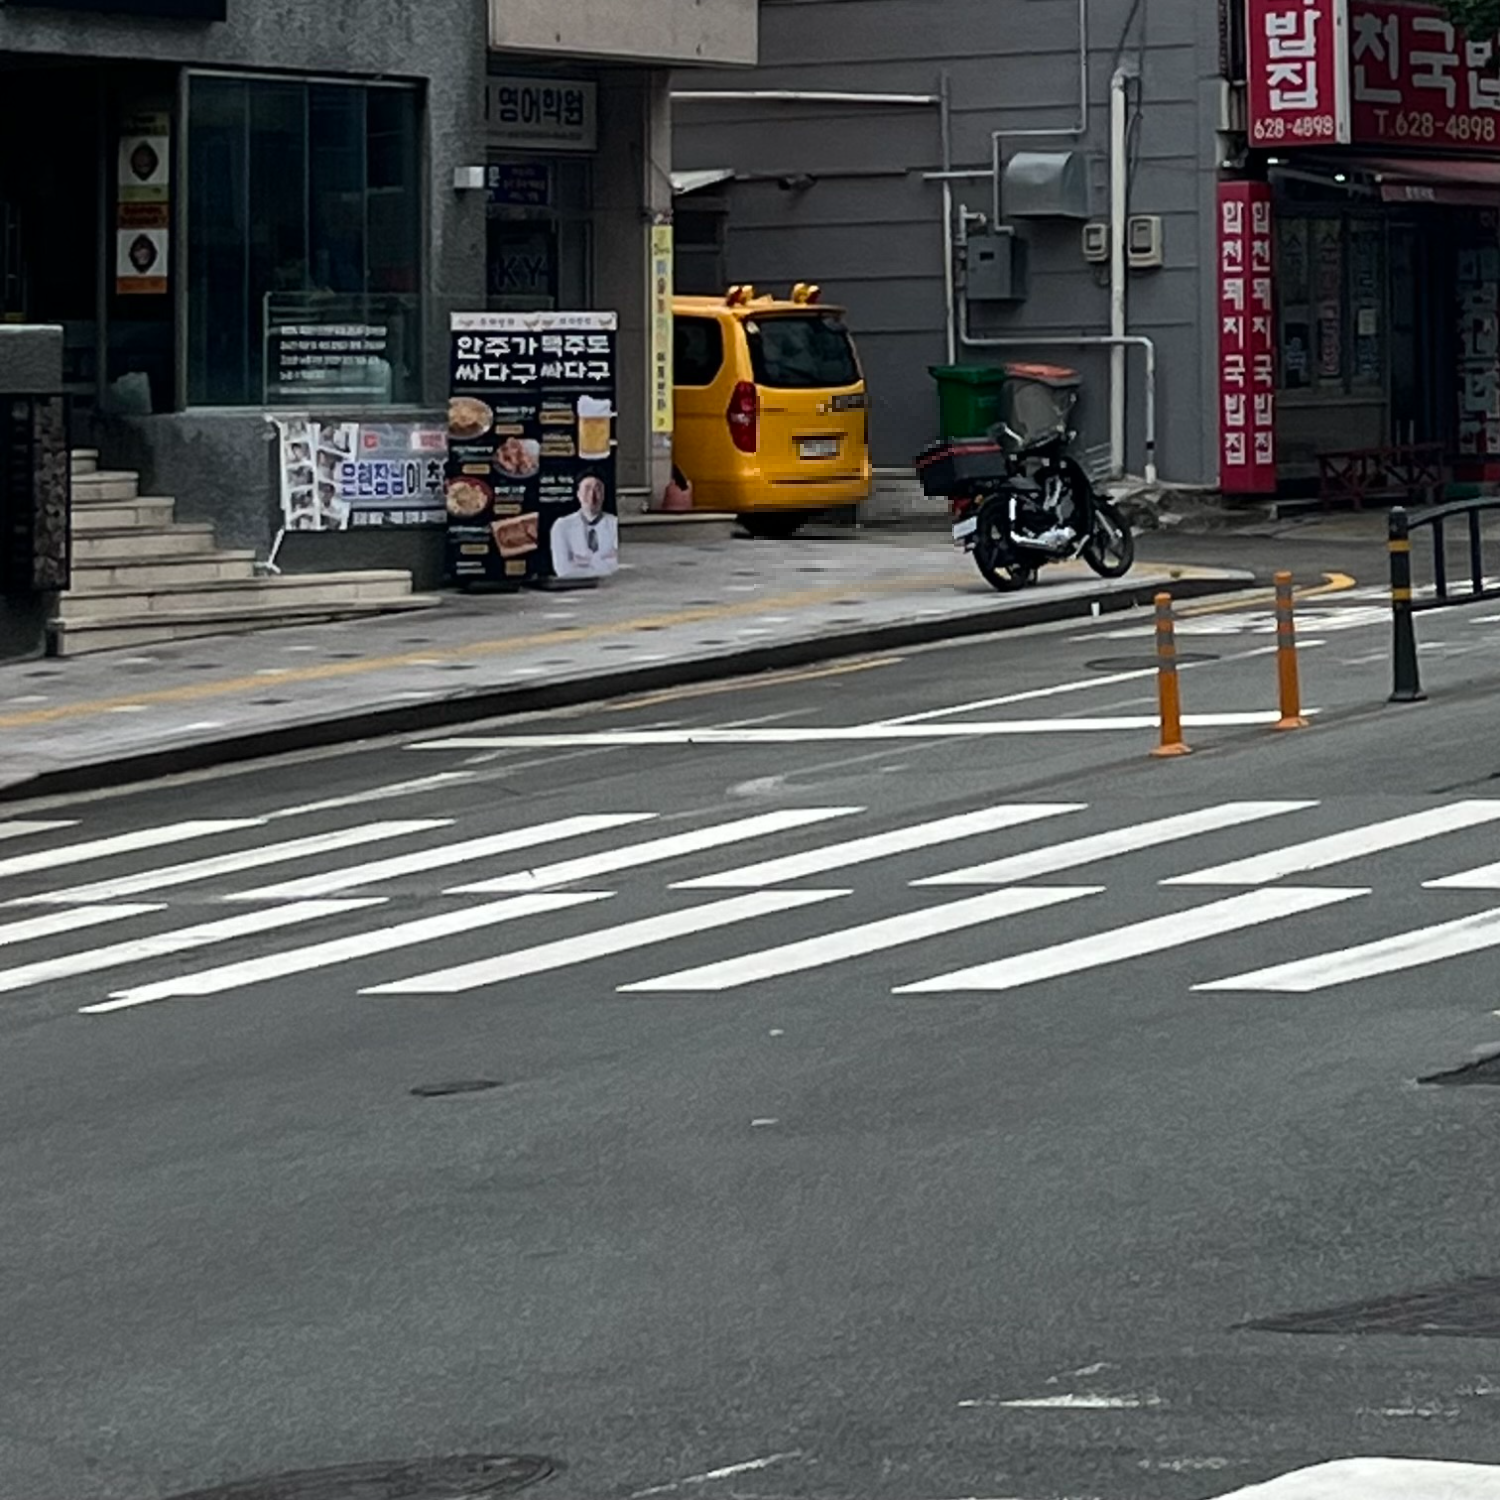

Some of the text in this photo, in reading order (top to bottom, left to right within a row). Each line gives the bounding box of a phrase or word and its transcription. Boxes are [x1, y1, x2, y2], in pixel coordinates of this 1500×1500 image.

[499, 87, 585, 127] 영어학원
[1254, 115, 1335, 140] 628-4898
[1374, 109, 1496, 142] T.628-4898
[457, 335, 538, 360] 안주가
[541, 335, 611, 358] 맥주도
[455, 362, 538, 384] 싸다구
[540, 360, 611, 381] 싸다구
